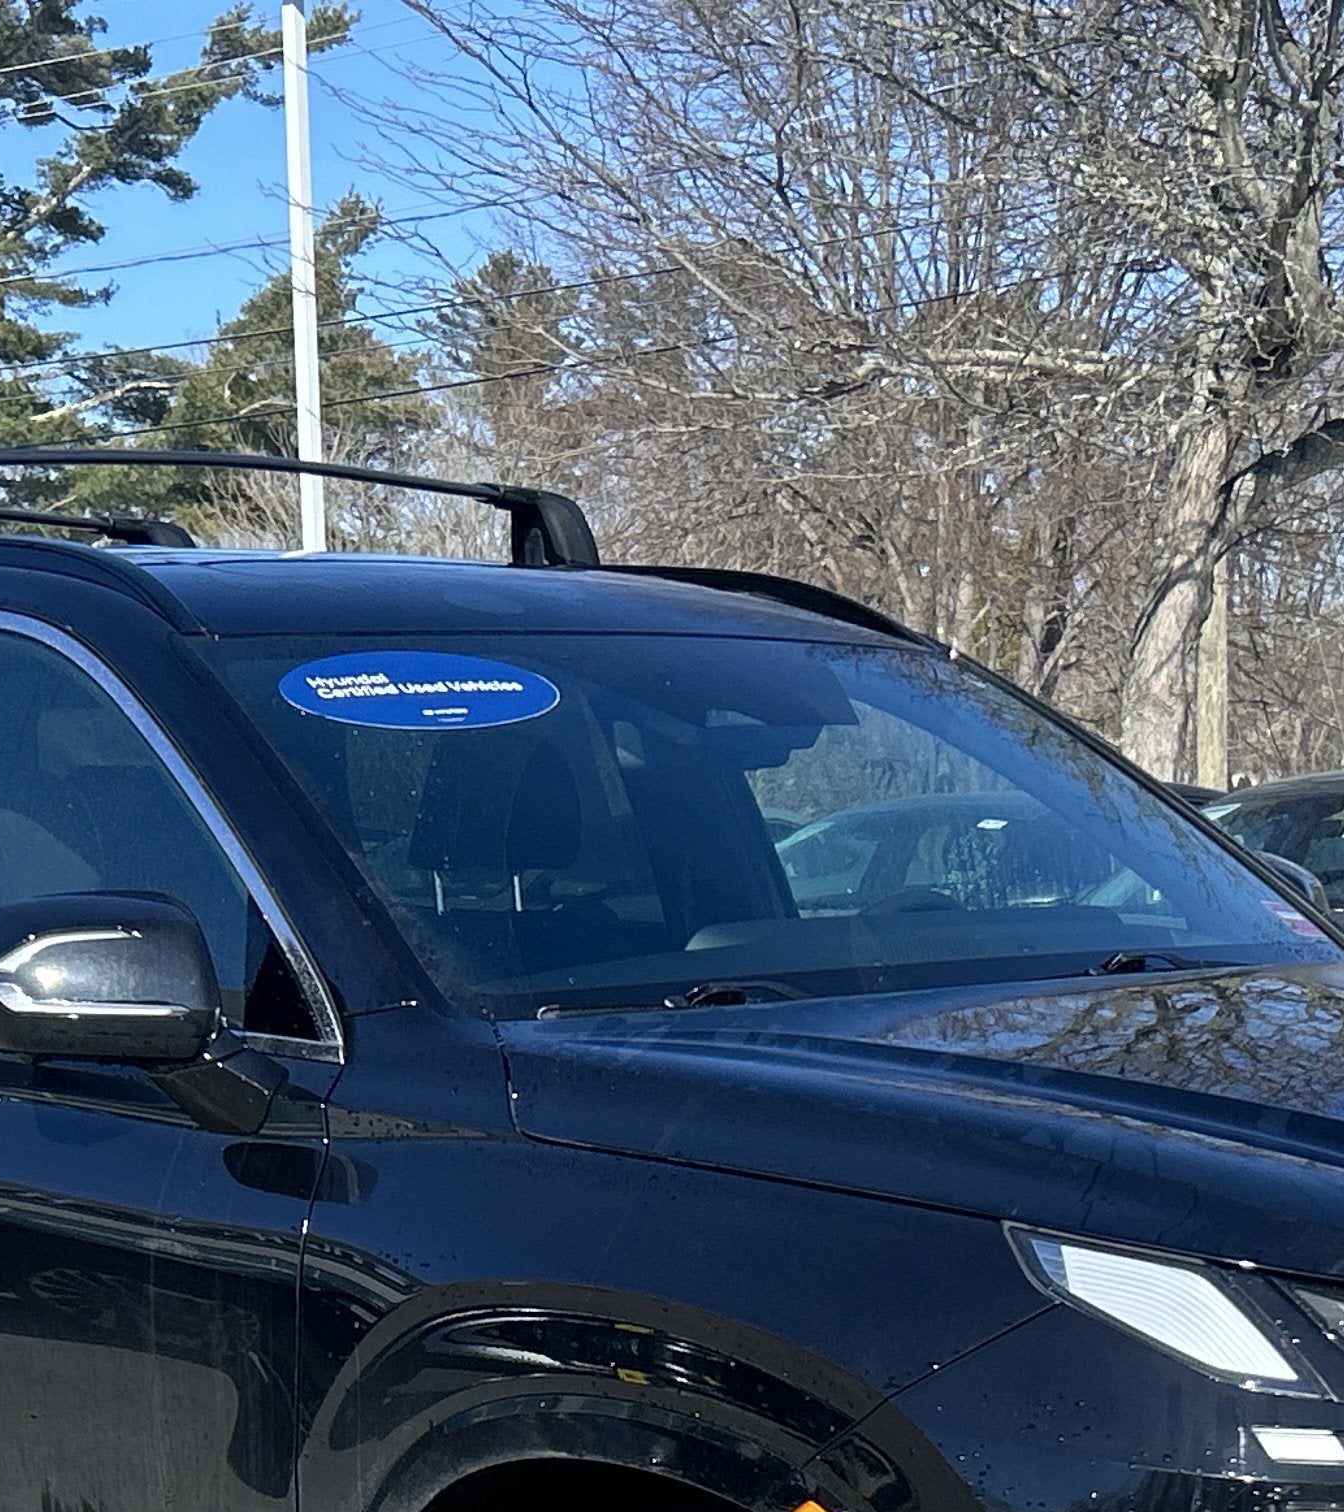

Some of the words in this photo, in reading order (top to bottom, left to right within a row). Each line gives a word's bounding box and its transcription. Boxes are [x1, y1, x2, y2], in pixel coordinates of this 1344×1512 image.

[305, 672, 389, 689] Hyundai
[316, 683, 399, 699] Certified
[397, 682, 448, 694] Used
[445, 680, 523, 693] Vehicles
